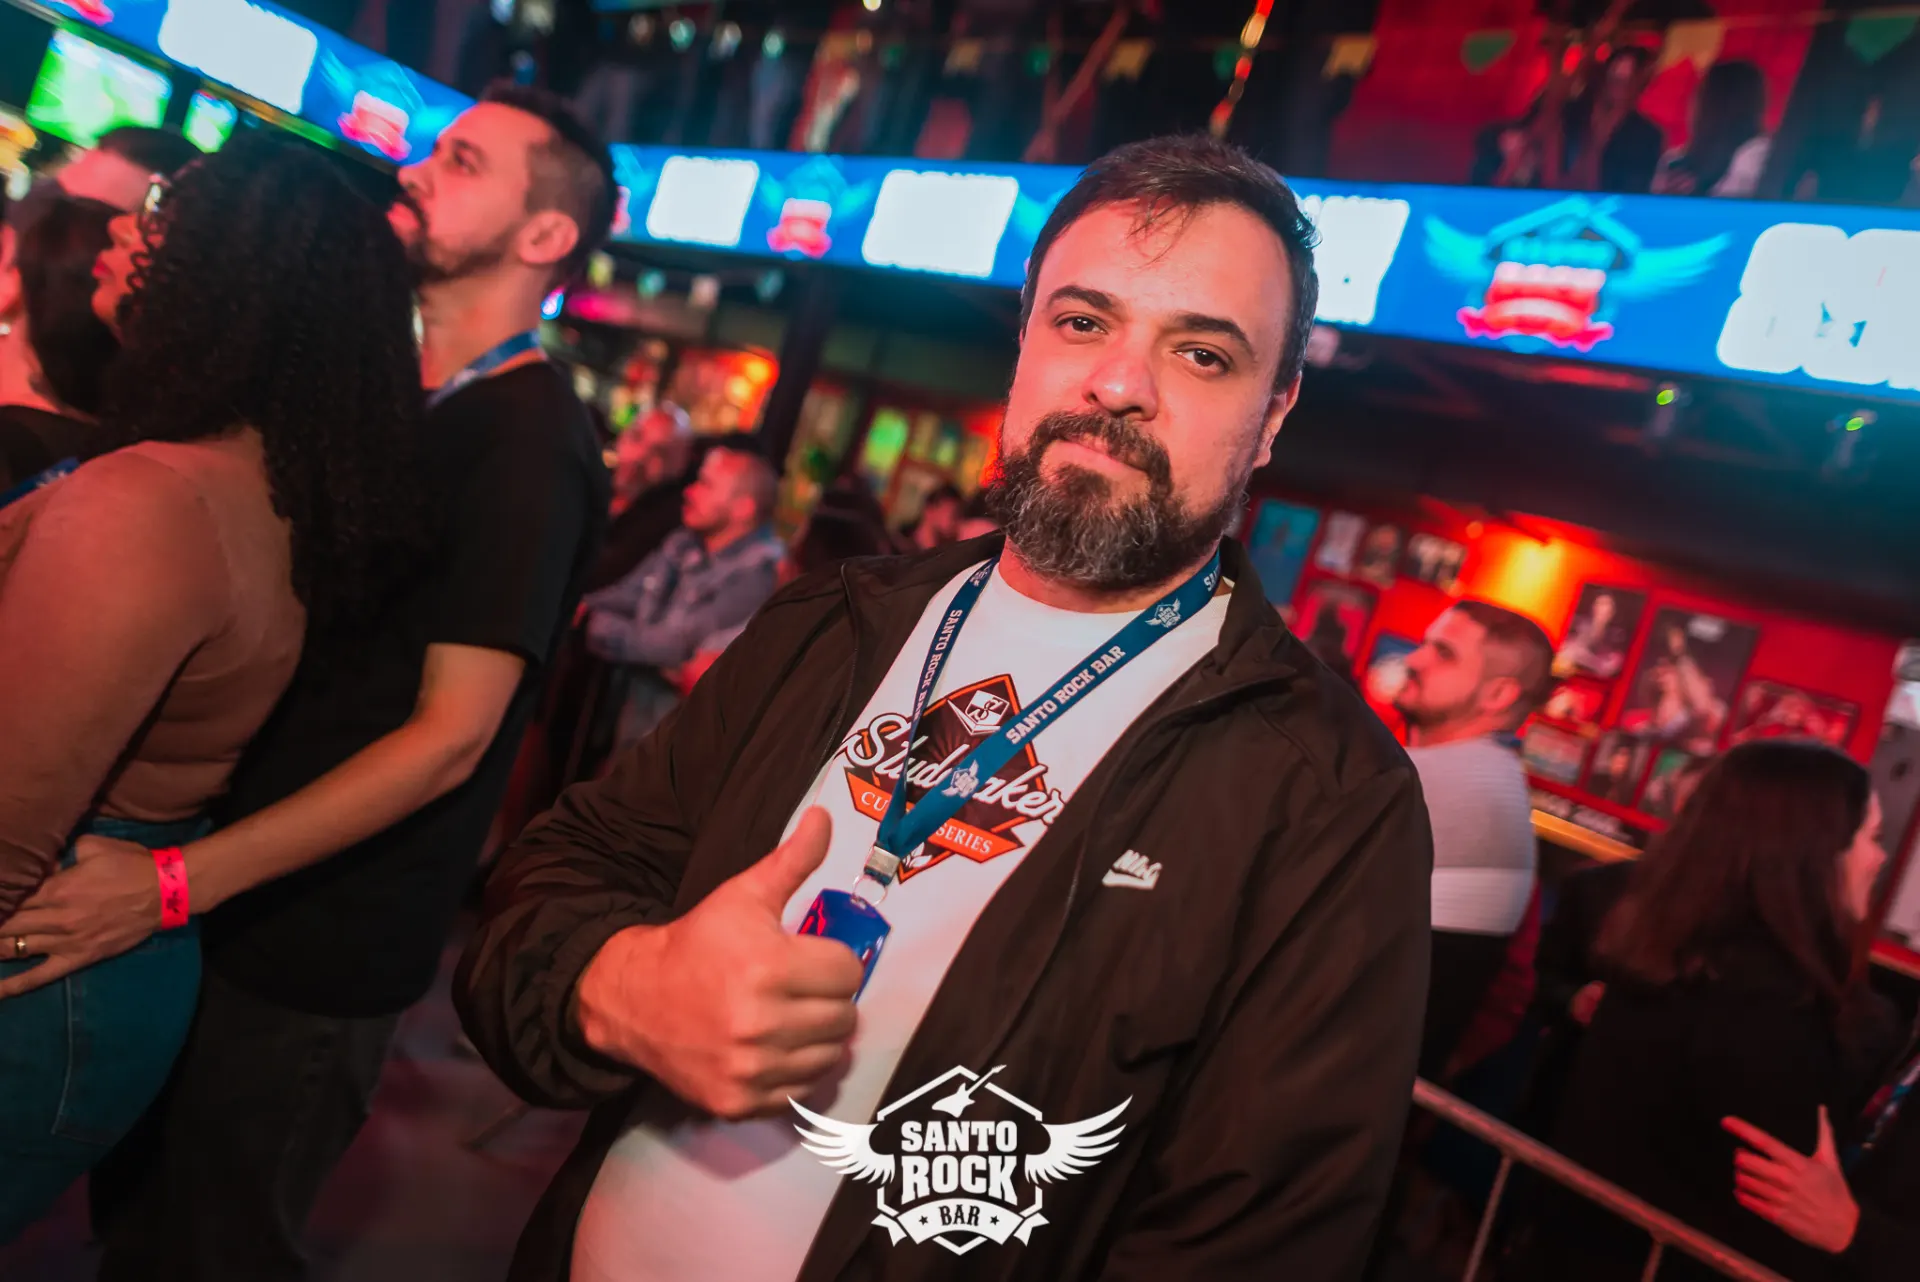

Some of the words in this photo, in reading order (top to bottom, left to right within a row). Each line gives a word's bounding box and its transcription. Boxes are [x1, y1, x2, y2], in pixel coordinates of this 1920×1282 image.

[934, 609, 963, 651] SANTO
[921, 652, 943, 689] ROCK
[1005, 699, 1058, 744] SANTO
[1053, 668, 1096, 704] ROCK
[1090, 645, 1126, 675] BAR
[935, 822, 993, 856] SERIES
